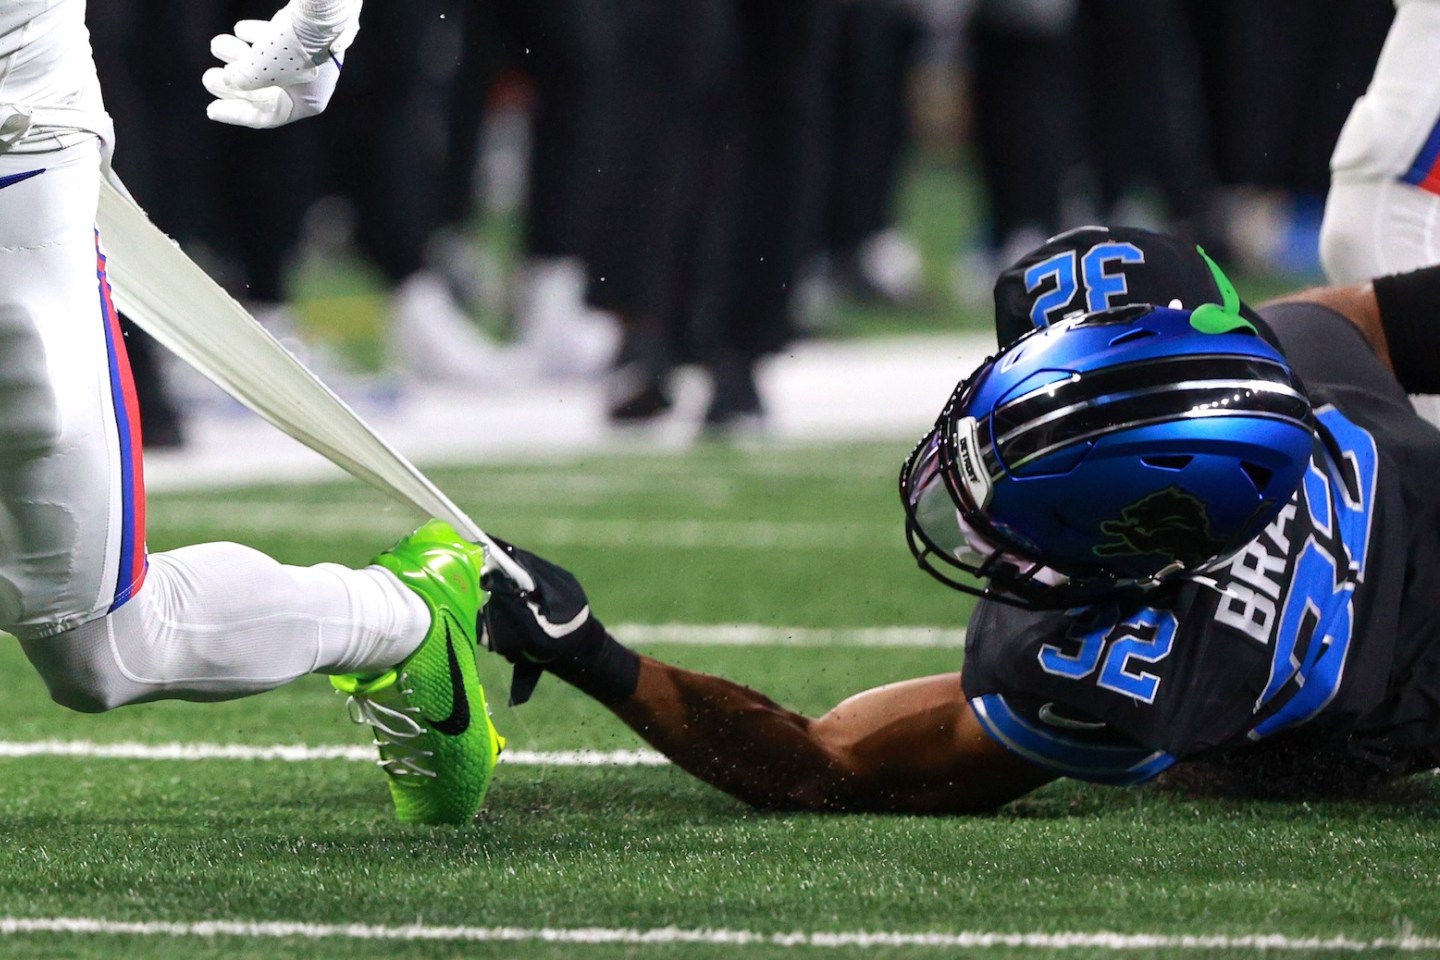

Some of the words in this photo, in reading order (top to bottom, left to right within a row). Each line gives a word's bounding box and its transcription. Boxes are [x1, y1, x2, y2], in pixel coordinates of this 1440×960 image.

[959, 436, 980, 483] DETROIT
[1213, 488, 1298, 644] BRA
[1036, 604, 1180, 705] 32
